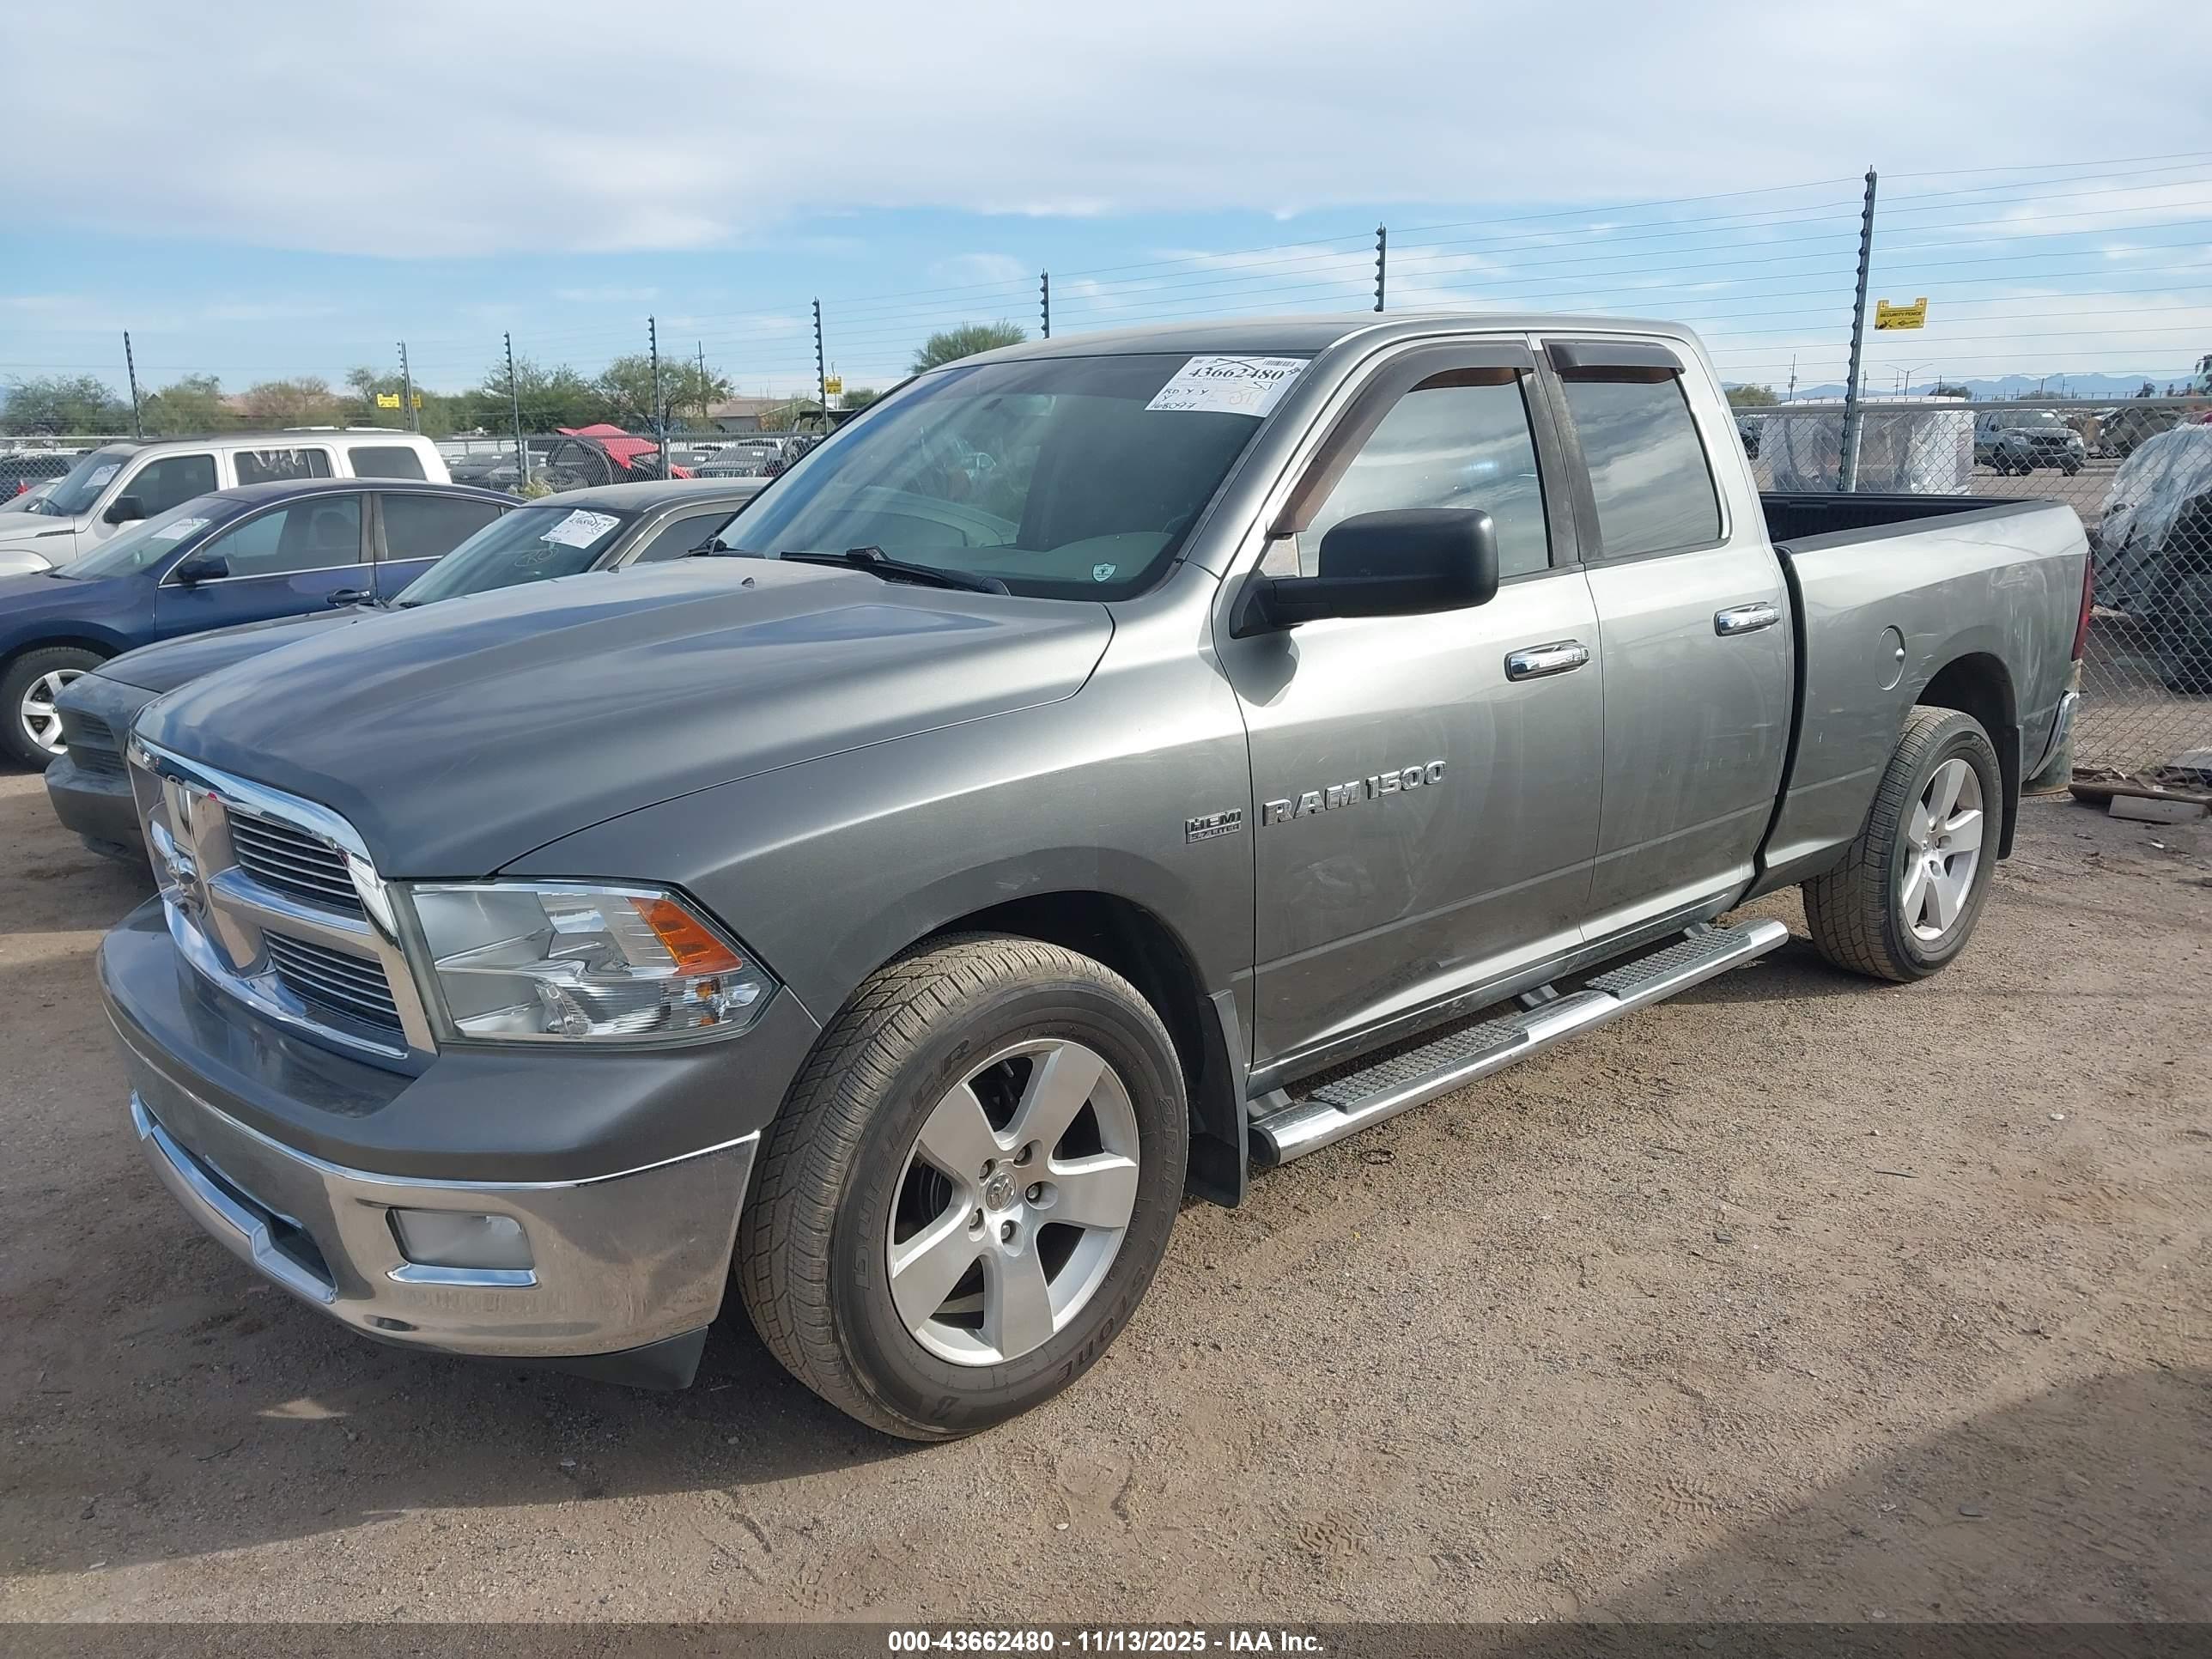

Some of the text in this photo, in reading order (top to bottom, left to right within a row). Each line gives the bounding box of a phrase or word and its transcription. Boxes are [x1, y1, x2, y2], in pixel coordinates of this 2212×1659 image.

[1188, 367, 1285, 380] 43662480
[1262, 761, 1447, 826] RAM 1500
[1189, 810, 1241, 832] HEMI
[1210, 823, 1240, 836] LITER
